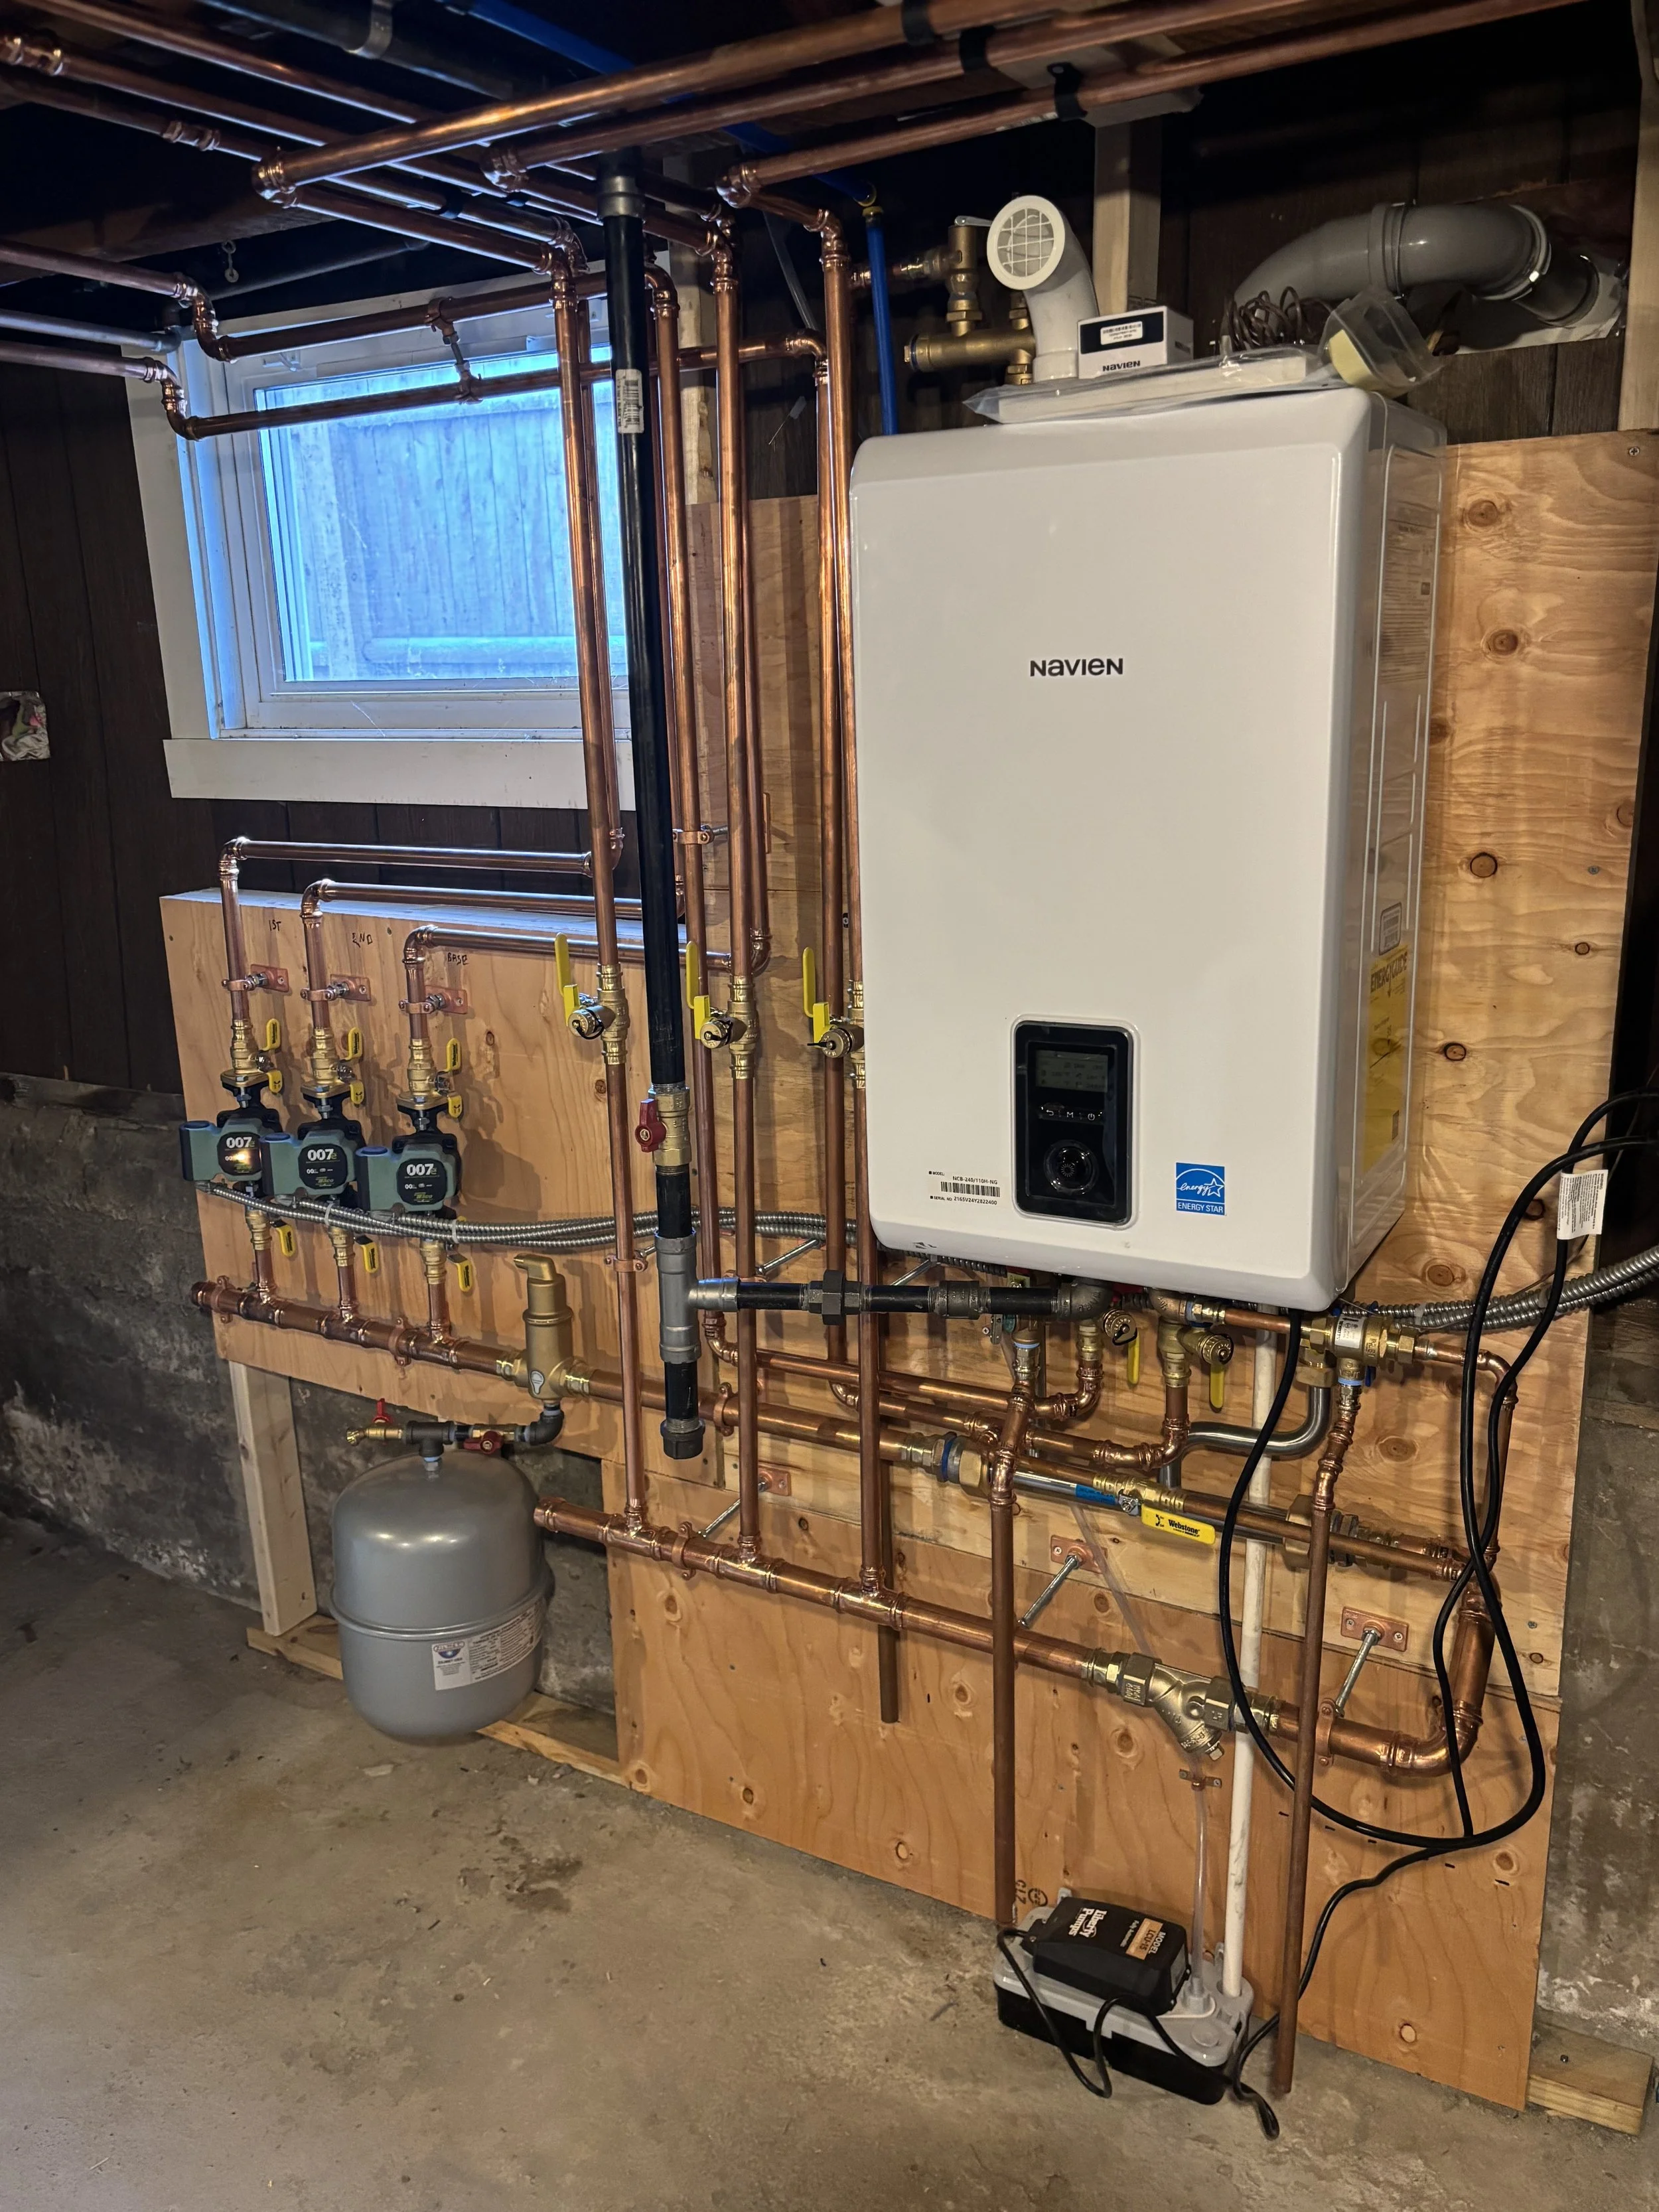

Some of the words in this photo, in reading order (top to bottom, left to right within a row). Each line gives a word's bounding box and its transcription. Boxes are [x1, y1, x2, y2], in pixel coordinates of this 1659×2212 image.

[447, 952, 469, 966] BASE
[952, 1175, 998, 1185] NCB-240/110H-NG
[1177, 1202, 1204, 1212] ENERGY
[1206, 1205, 1224, 1213] STAR
[1168, 1518, 1198, 1534] Webstone
[1068, 1907, 1092, 1937] Pumps
[1079, 1908, 1108, 1938] Liberty
[1148, 1931, 1167, 1955] MODEL
